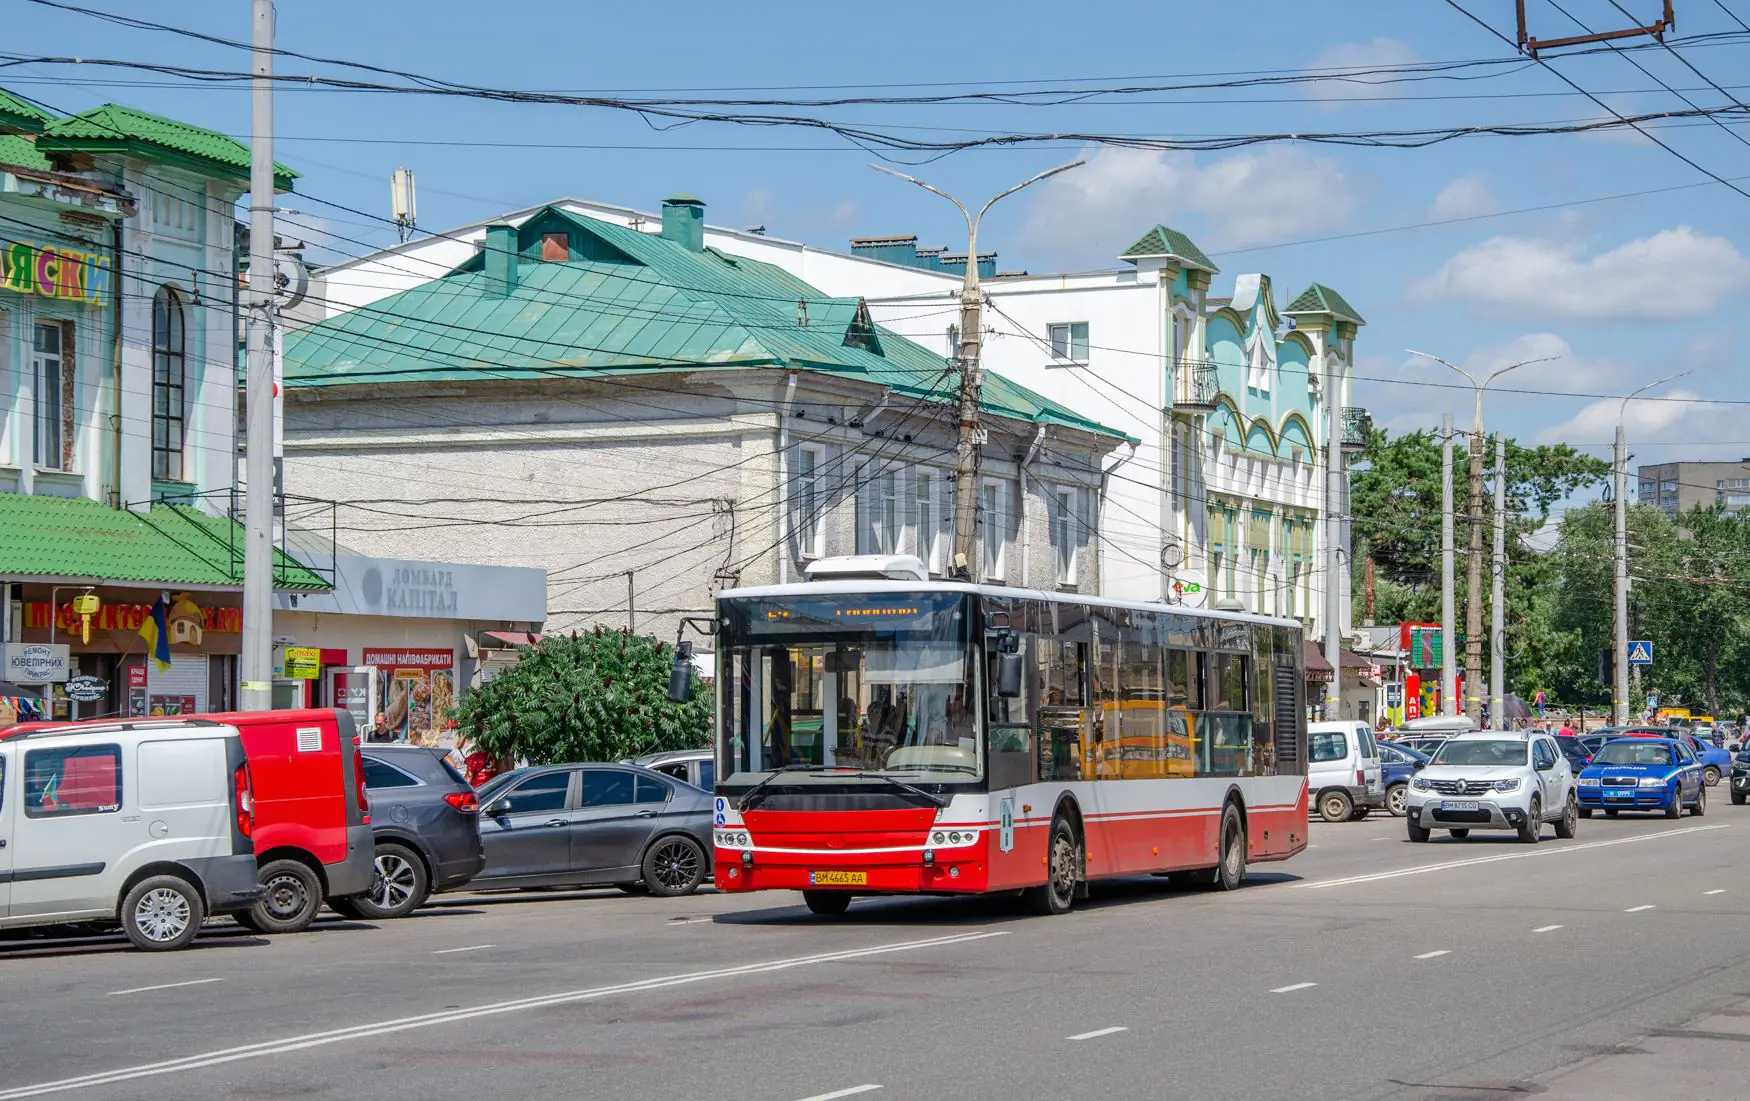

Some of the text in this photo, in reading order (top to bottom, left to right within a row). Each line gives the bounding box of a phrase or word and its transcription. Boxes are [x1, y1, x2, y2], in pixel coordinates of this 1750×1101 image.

[0, 242, 110, 306] ЯСКИ
[392, 568, 454, 589] ЛОМБАРД
[386, 588, 458, 612] КАПІТАЛ
[203, 607, 243, 633] ХАТ
[23, 647, 51, 657] РЕМОНТ
[11, 657, 63, 668] ЮВЕЛІРНИХ
[366, 653, 451, 666] ДОМАШНІ НАПІВФАБРИКАТИ
[24, 667, 51, 679] ПРИКРАС
[816, 873, 863, 883] BM 4665 AA
